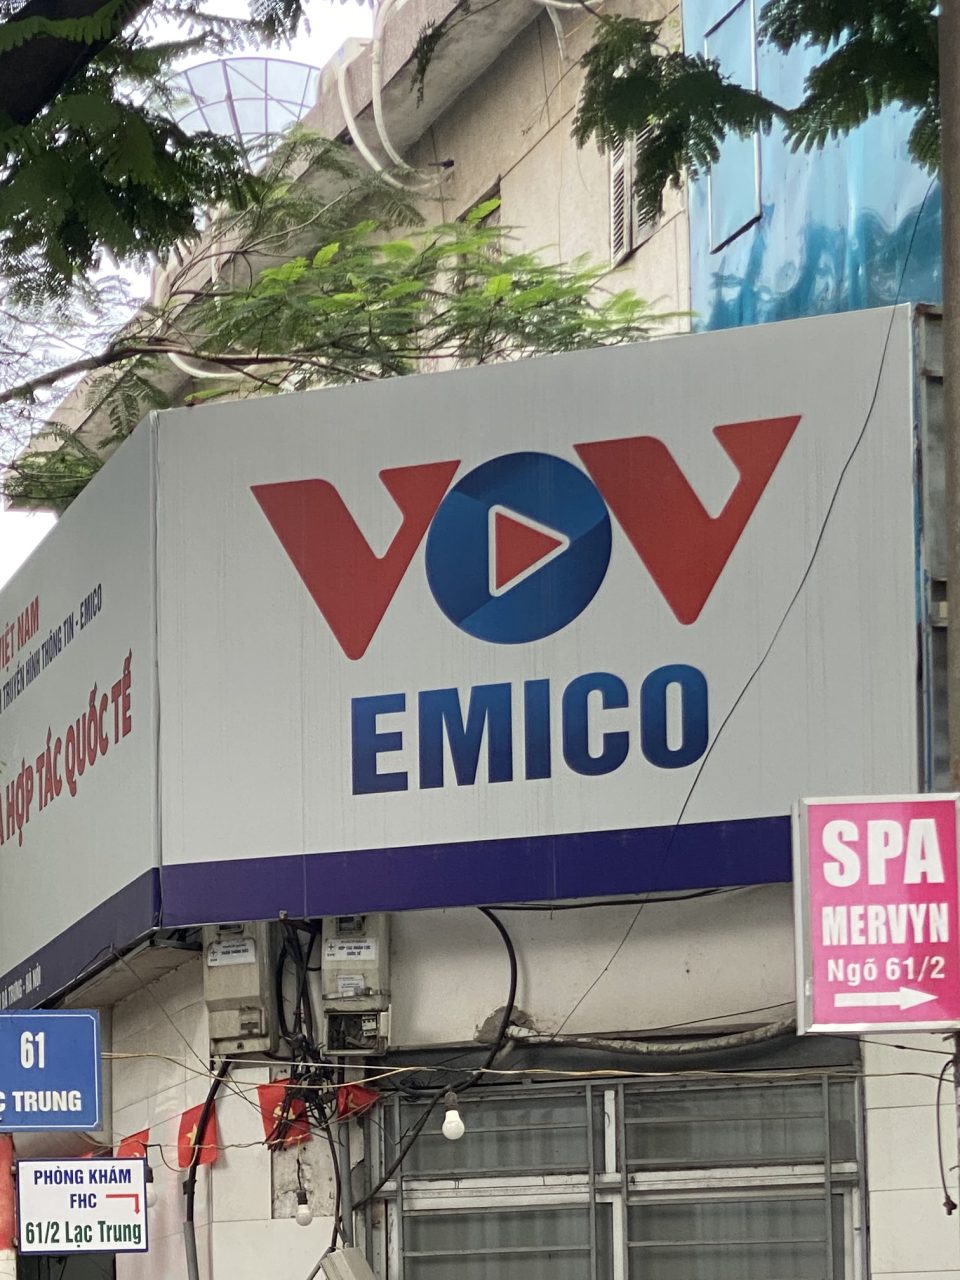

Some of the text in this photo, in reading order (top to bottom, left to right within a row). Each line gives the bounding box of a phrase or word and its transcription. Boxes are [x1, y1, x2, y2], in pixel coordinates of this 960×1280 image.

[250, 414, 803, 661] VOV
[17, 595, 39, 651] NAM
[41, 629, 62, 670] THÔNG
[63, 611, 74, 648] TIN
[80, 583, 102, 631] EMICO
[6, 757, 34, 847] HỢP
[36, 725, 62, 812] TÁC
[65, 681, 109, 797] QUỐC
[112, 647, 132, 745] TẾ
[351, 663, 709, 796] EMICO
[822, 818, 945, 888] SPA
[821, 903, 950, 946] MERVYN
[827, 956, 945, 986] Ngõ 61/2
[20, 1031, 45, 1069] 61
[12, 1090, 82, 1112] TRUNG
[33, 1165, 132, 1185] PHÒNG KHÁM
[69, 1193, 97, 1209] FHC
[25, 1220, 141, 1248] 61/2 Lạc Trung
